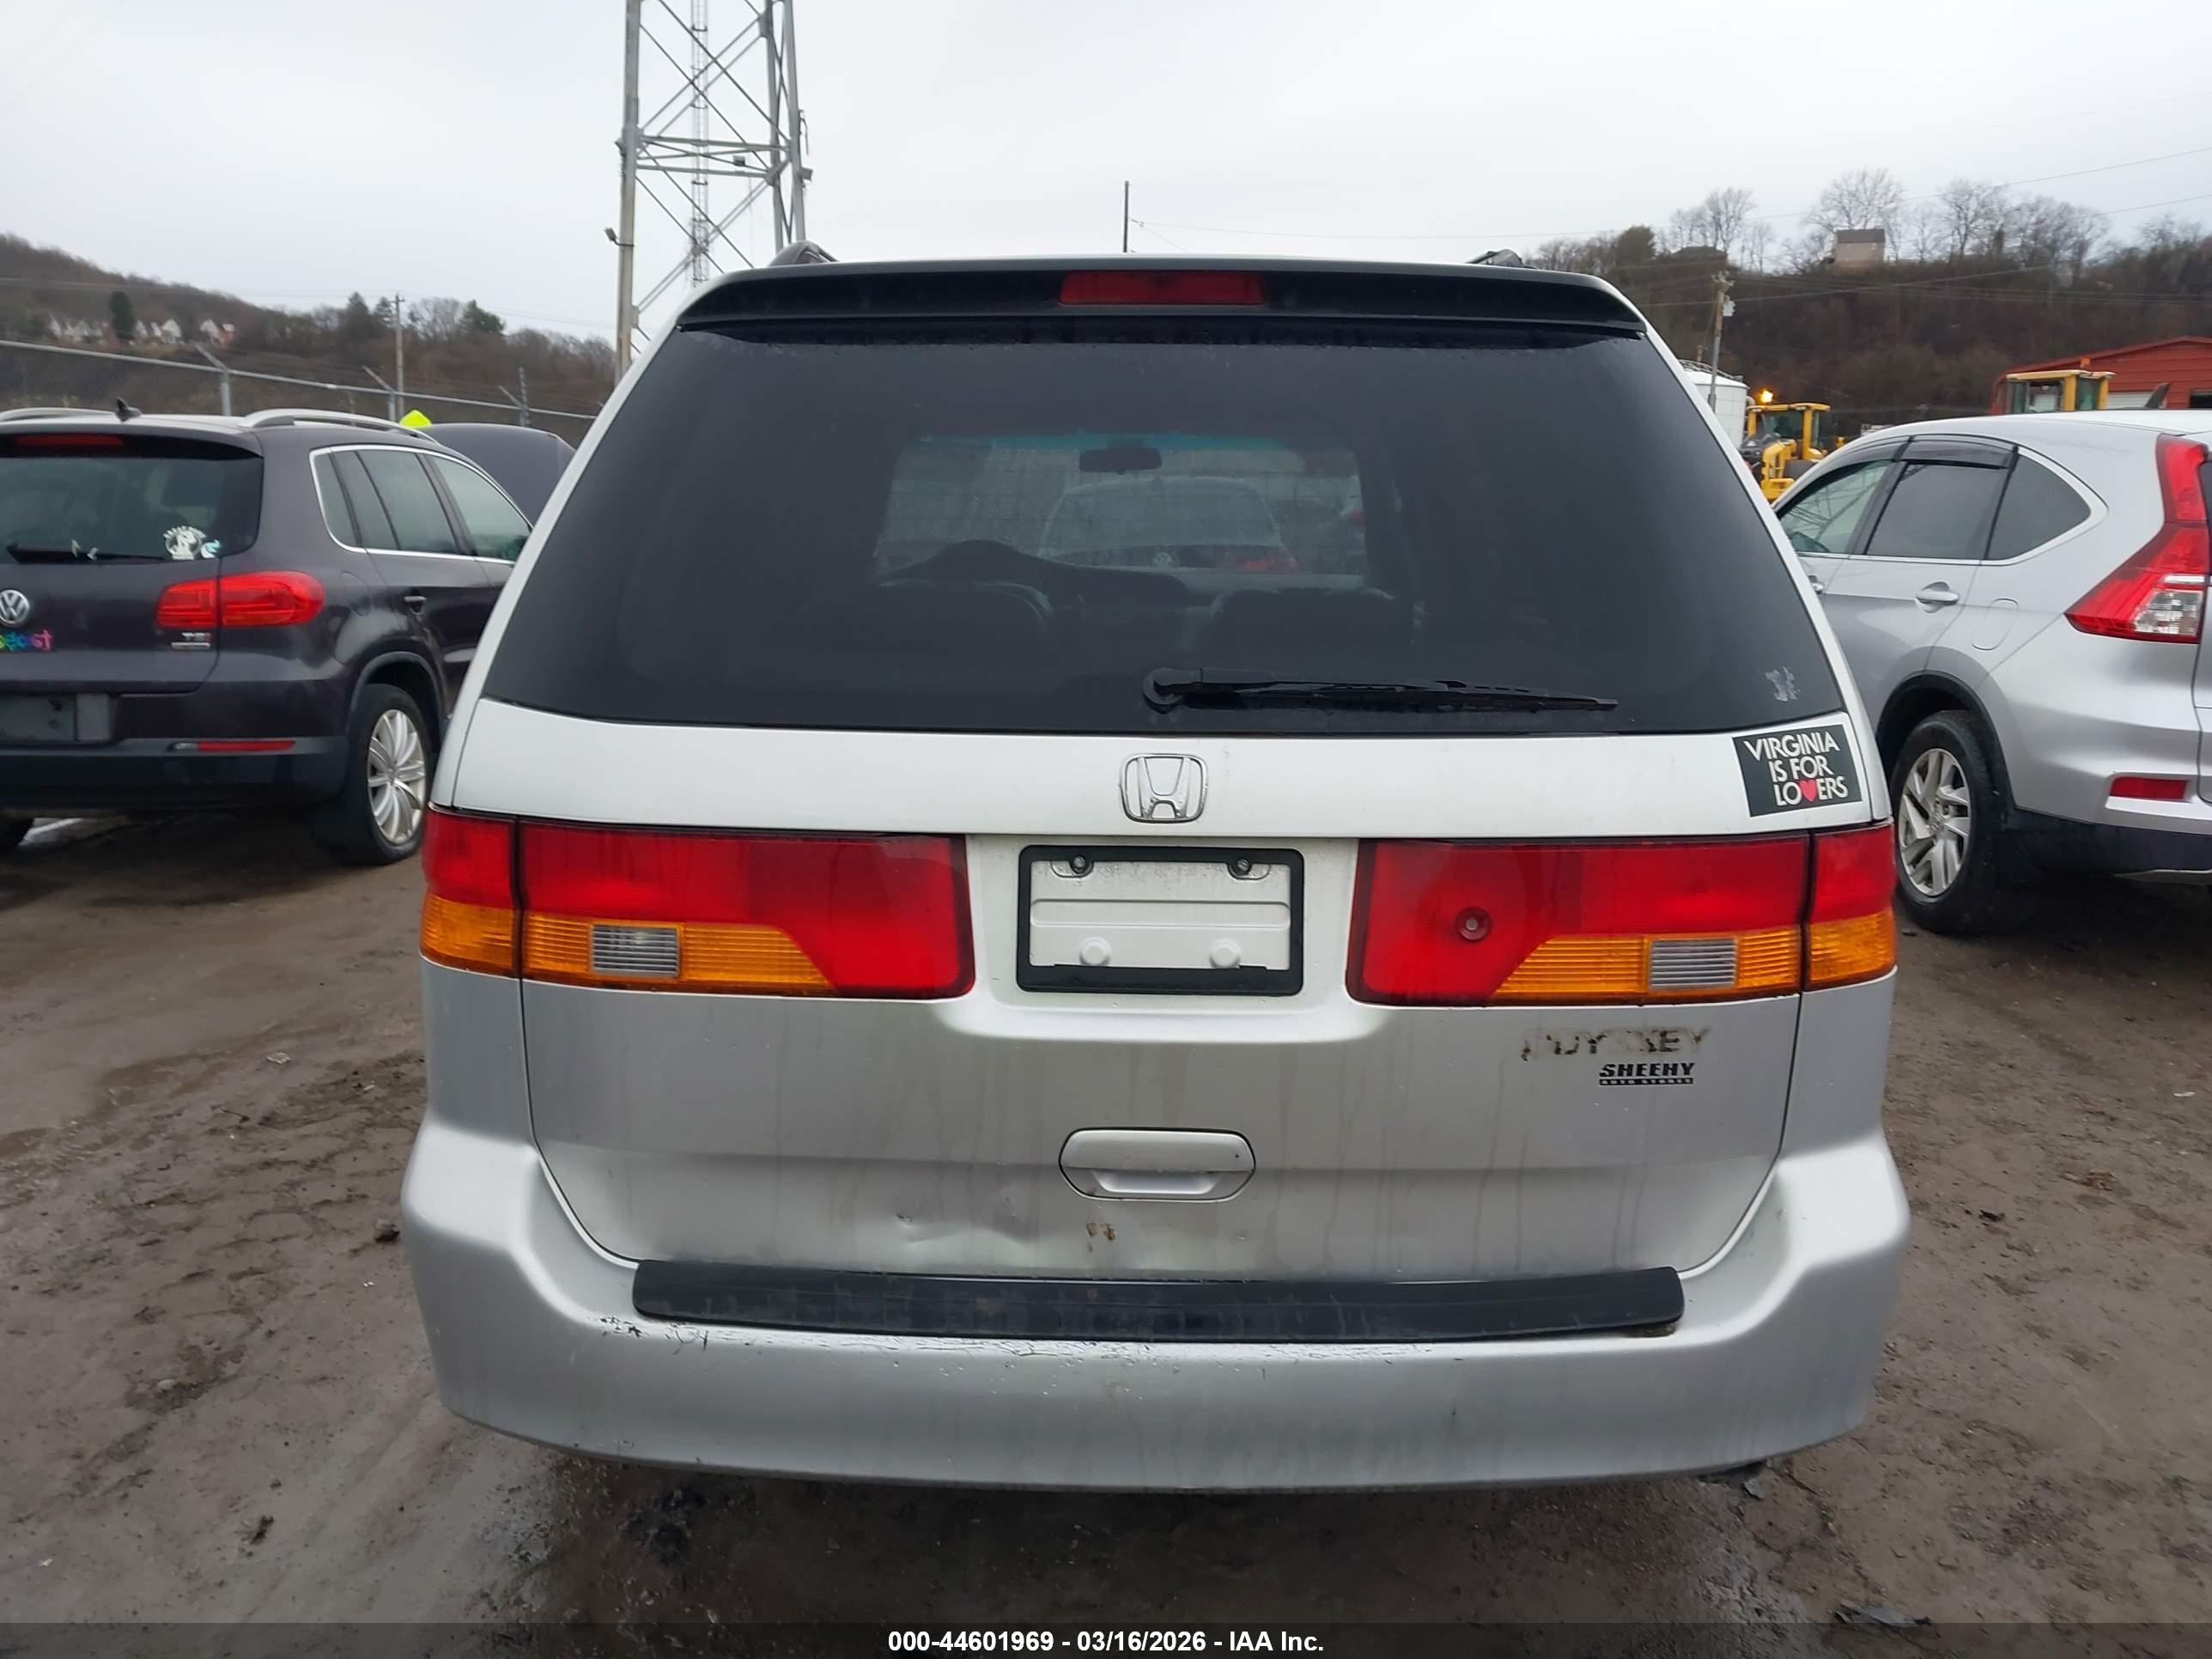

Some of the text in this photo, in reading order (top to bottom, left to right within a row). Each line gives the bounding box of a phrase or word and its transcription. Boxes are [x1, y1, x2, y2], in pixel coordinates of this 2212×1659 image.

[1743, 732, 1840, 761] VIRGINIA
[1769, 756, 1834, 782] IS FOR
[1599, 1062, 1695, 1077] SHEEHY
